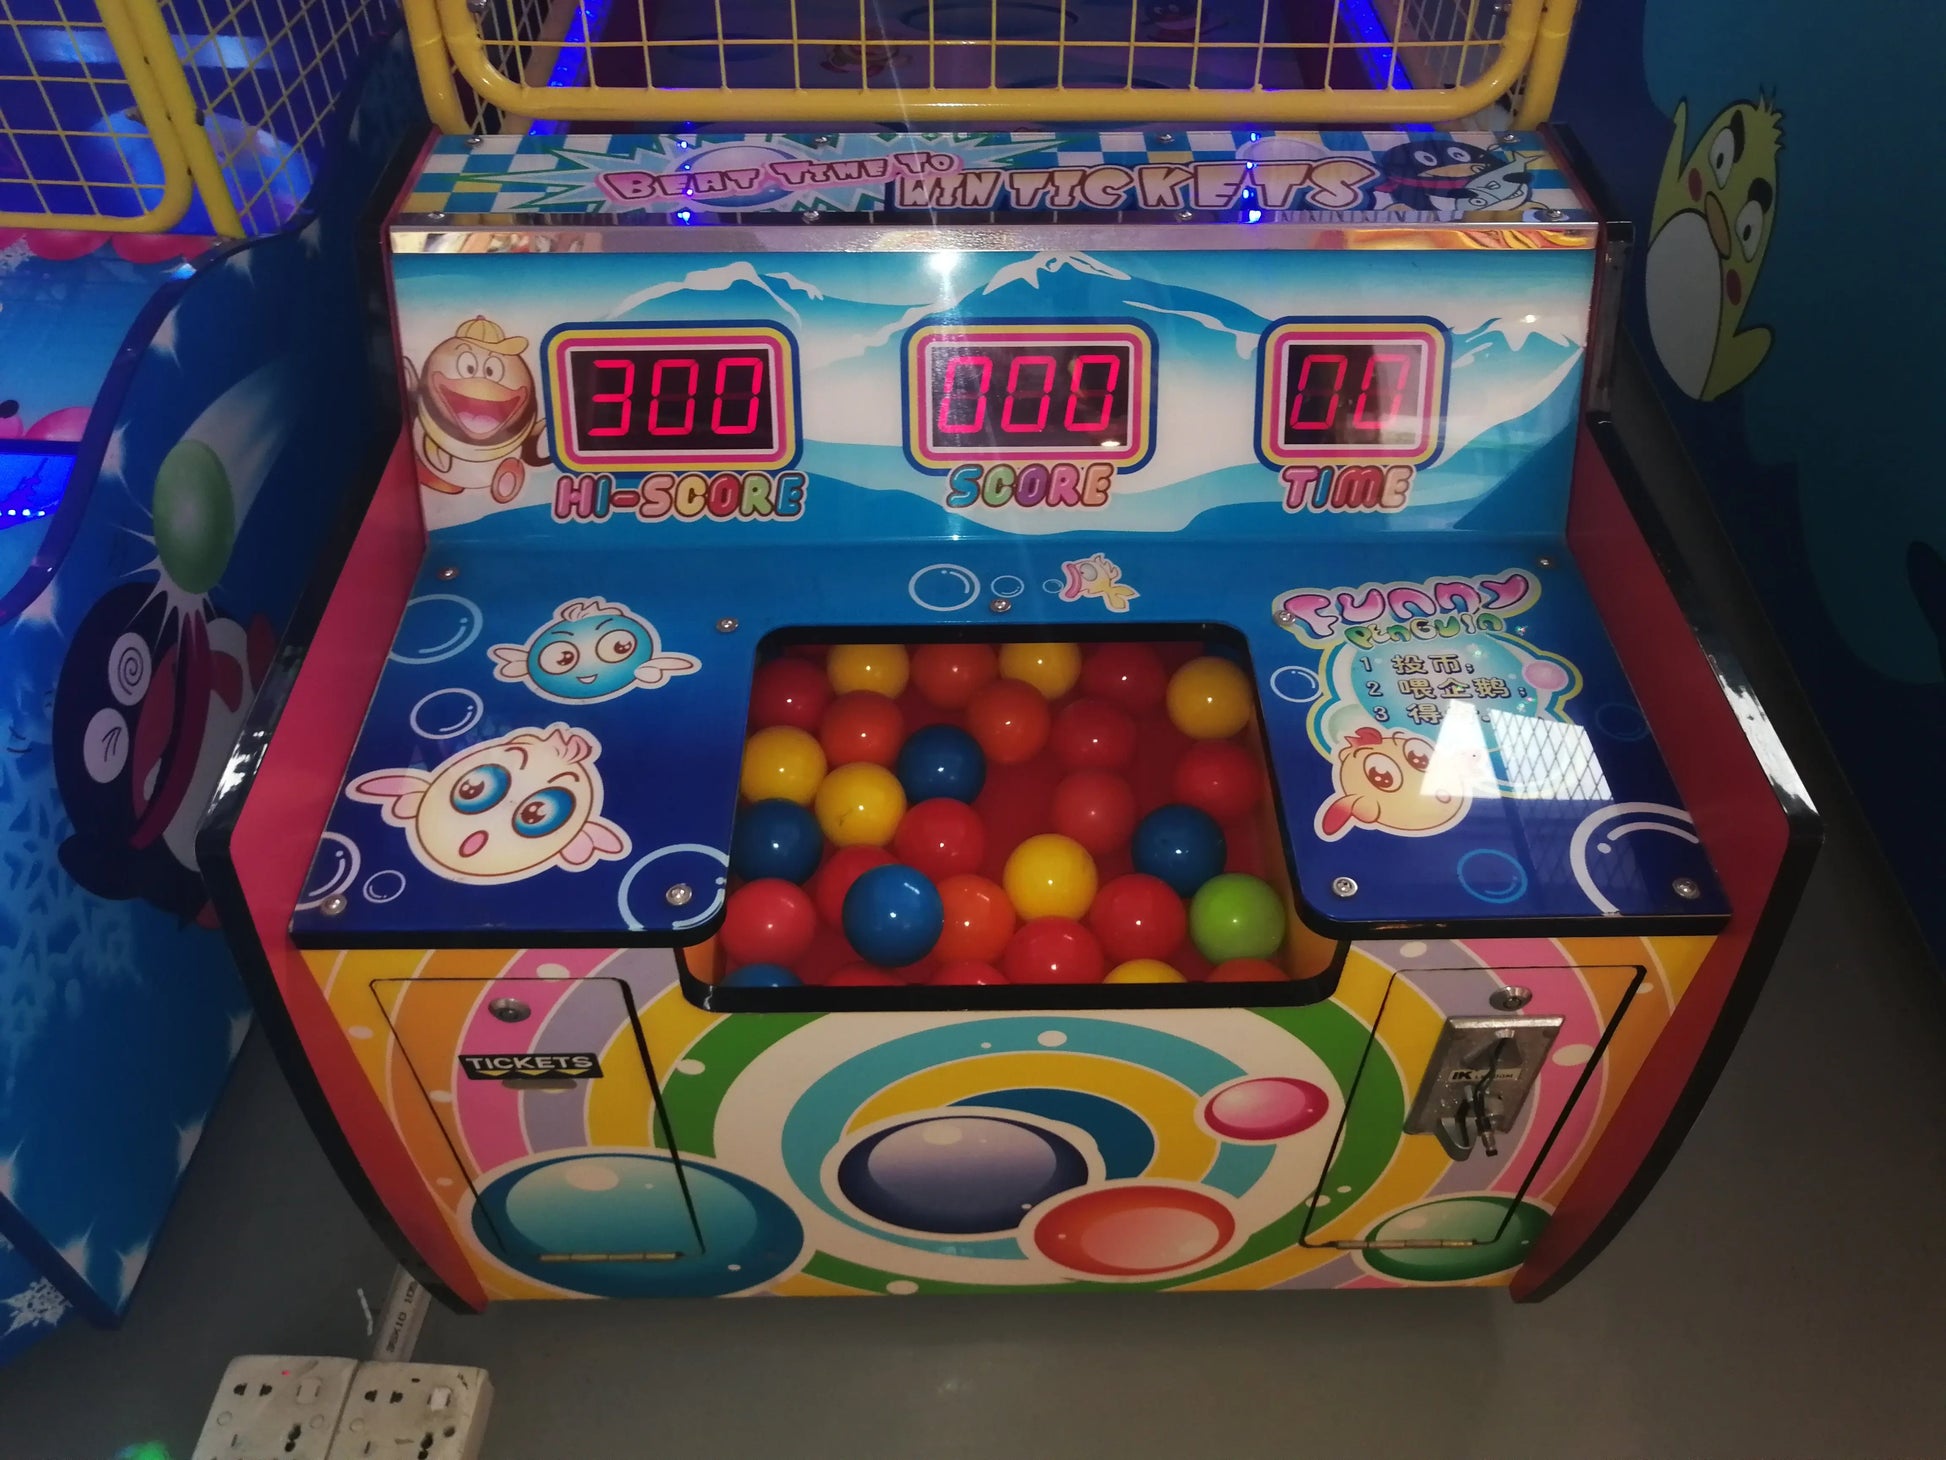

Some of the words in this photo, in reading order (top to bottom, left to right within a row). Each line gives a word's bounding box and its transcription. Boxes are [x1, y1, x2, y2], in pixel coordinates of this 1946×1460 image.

[604, 168, 760, 201] BEAT
[767, 158, 890, 186] TIME
[893, 151, 957, 175] TO
[899, 169, 1000, 208] WIN
[1007, 161, 1373, 210] TICKETS
[587, 358, 764, 437] 300
[937, 354, 1121, 434] 000
[1289, 353, 1408, 430] 00
[553, 472, 808, 521] HI-SCORE
[944, 462, 1113, 508] SCORE
[1281, 463, 1415, 512] TIME
[465, 1055, 594, 1070] TICKETS
